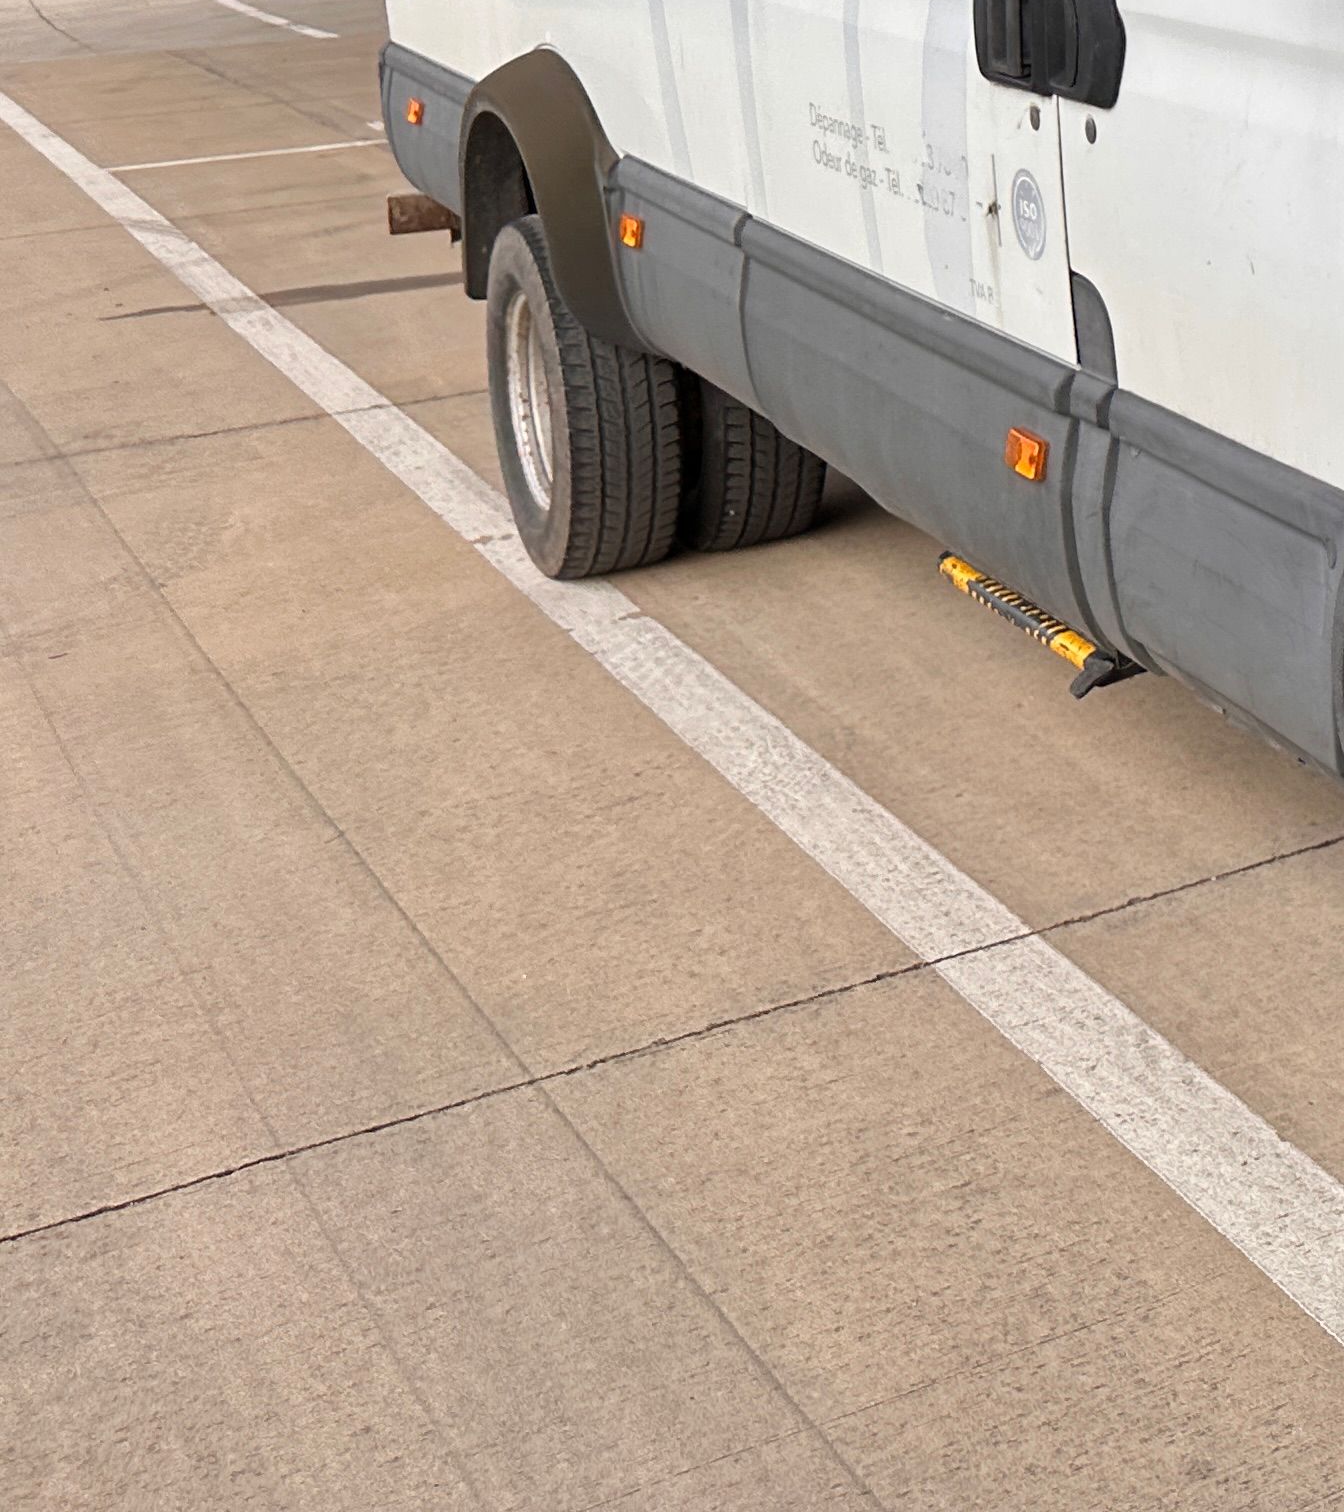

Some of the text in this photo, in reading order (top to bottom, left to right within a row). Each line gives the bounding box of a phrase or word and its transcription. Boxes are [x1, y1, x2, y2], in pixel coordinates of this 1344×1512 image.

[813, 140, 842, 172] Odeur
[845, 152, 858, 179] de
[860, 165, 878, 189] gaz
[1020, 198, 1038, 220] ISO
